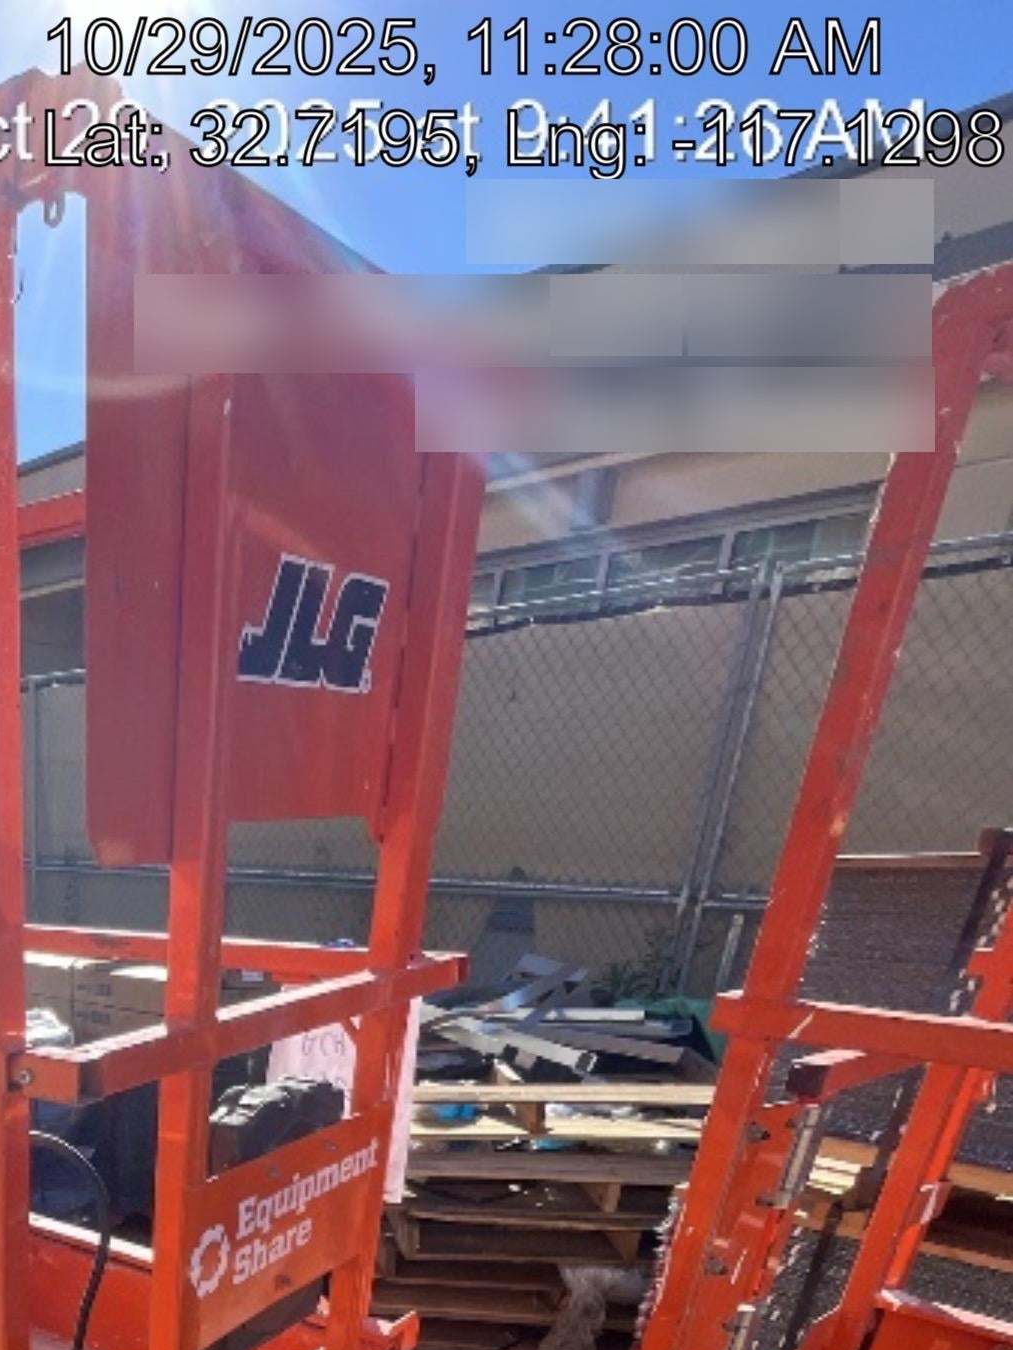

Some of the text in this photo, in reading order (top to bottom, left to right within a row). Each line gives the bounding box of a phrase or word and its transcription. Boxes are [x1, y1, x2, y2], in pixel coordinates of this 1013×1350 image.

[235, 551, 391, 694] JLG
[235, 1136, 380, 1241] Equipment
[231, 1217, 304, 1286] Share
